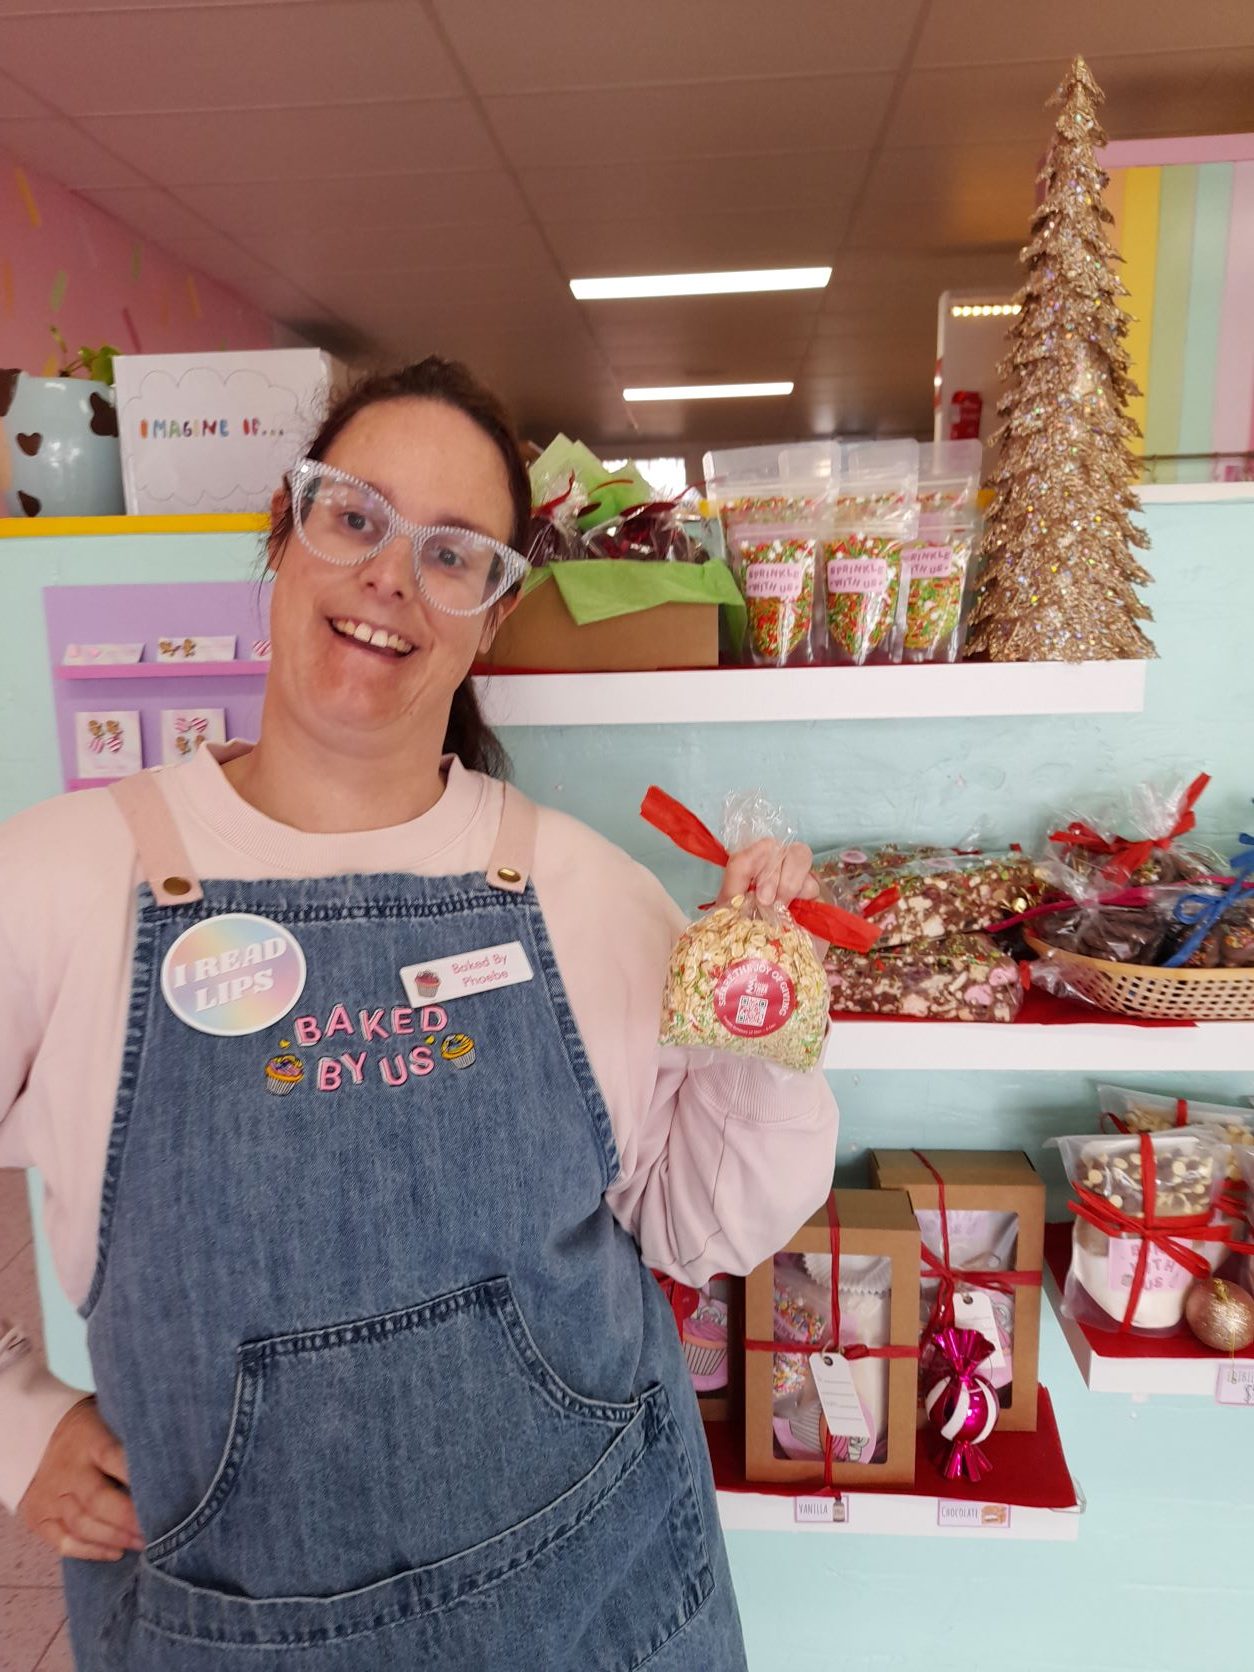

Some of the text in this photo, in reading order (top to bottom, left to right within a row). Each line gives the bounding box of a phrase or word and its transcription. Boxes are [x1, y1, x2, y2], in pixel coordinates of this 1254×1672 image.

[140, 418, 230, 439] IMAGINE
[748, 568, 800, 580] SPRINKLE
[830, 562, 885, 576] SPRINKLE
[752, 581, 777, 593] WITH
[834, 576, 861, 588] WITH
[174, 937, 287, 988] I READ
[451, 953, 508, 974] Baked By
[462, 970, 509, 987] Phoebe
[195, 968, 274, 1012] LIPS
[778, 981, 791, 1017] GIVING
[294, 1003, 449, 1047] BAKED
[316, 1045, 436, 1093] BY US
[798, 1503, 828, 1515] VANILLA
[941, 1505, 979, 1519] CHOCOLATE
